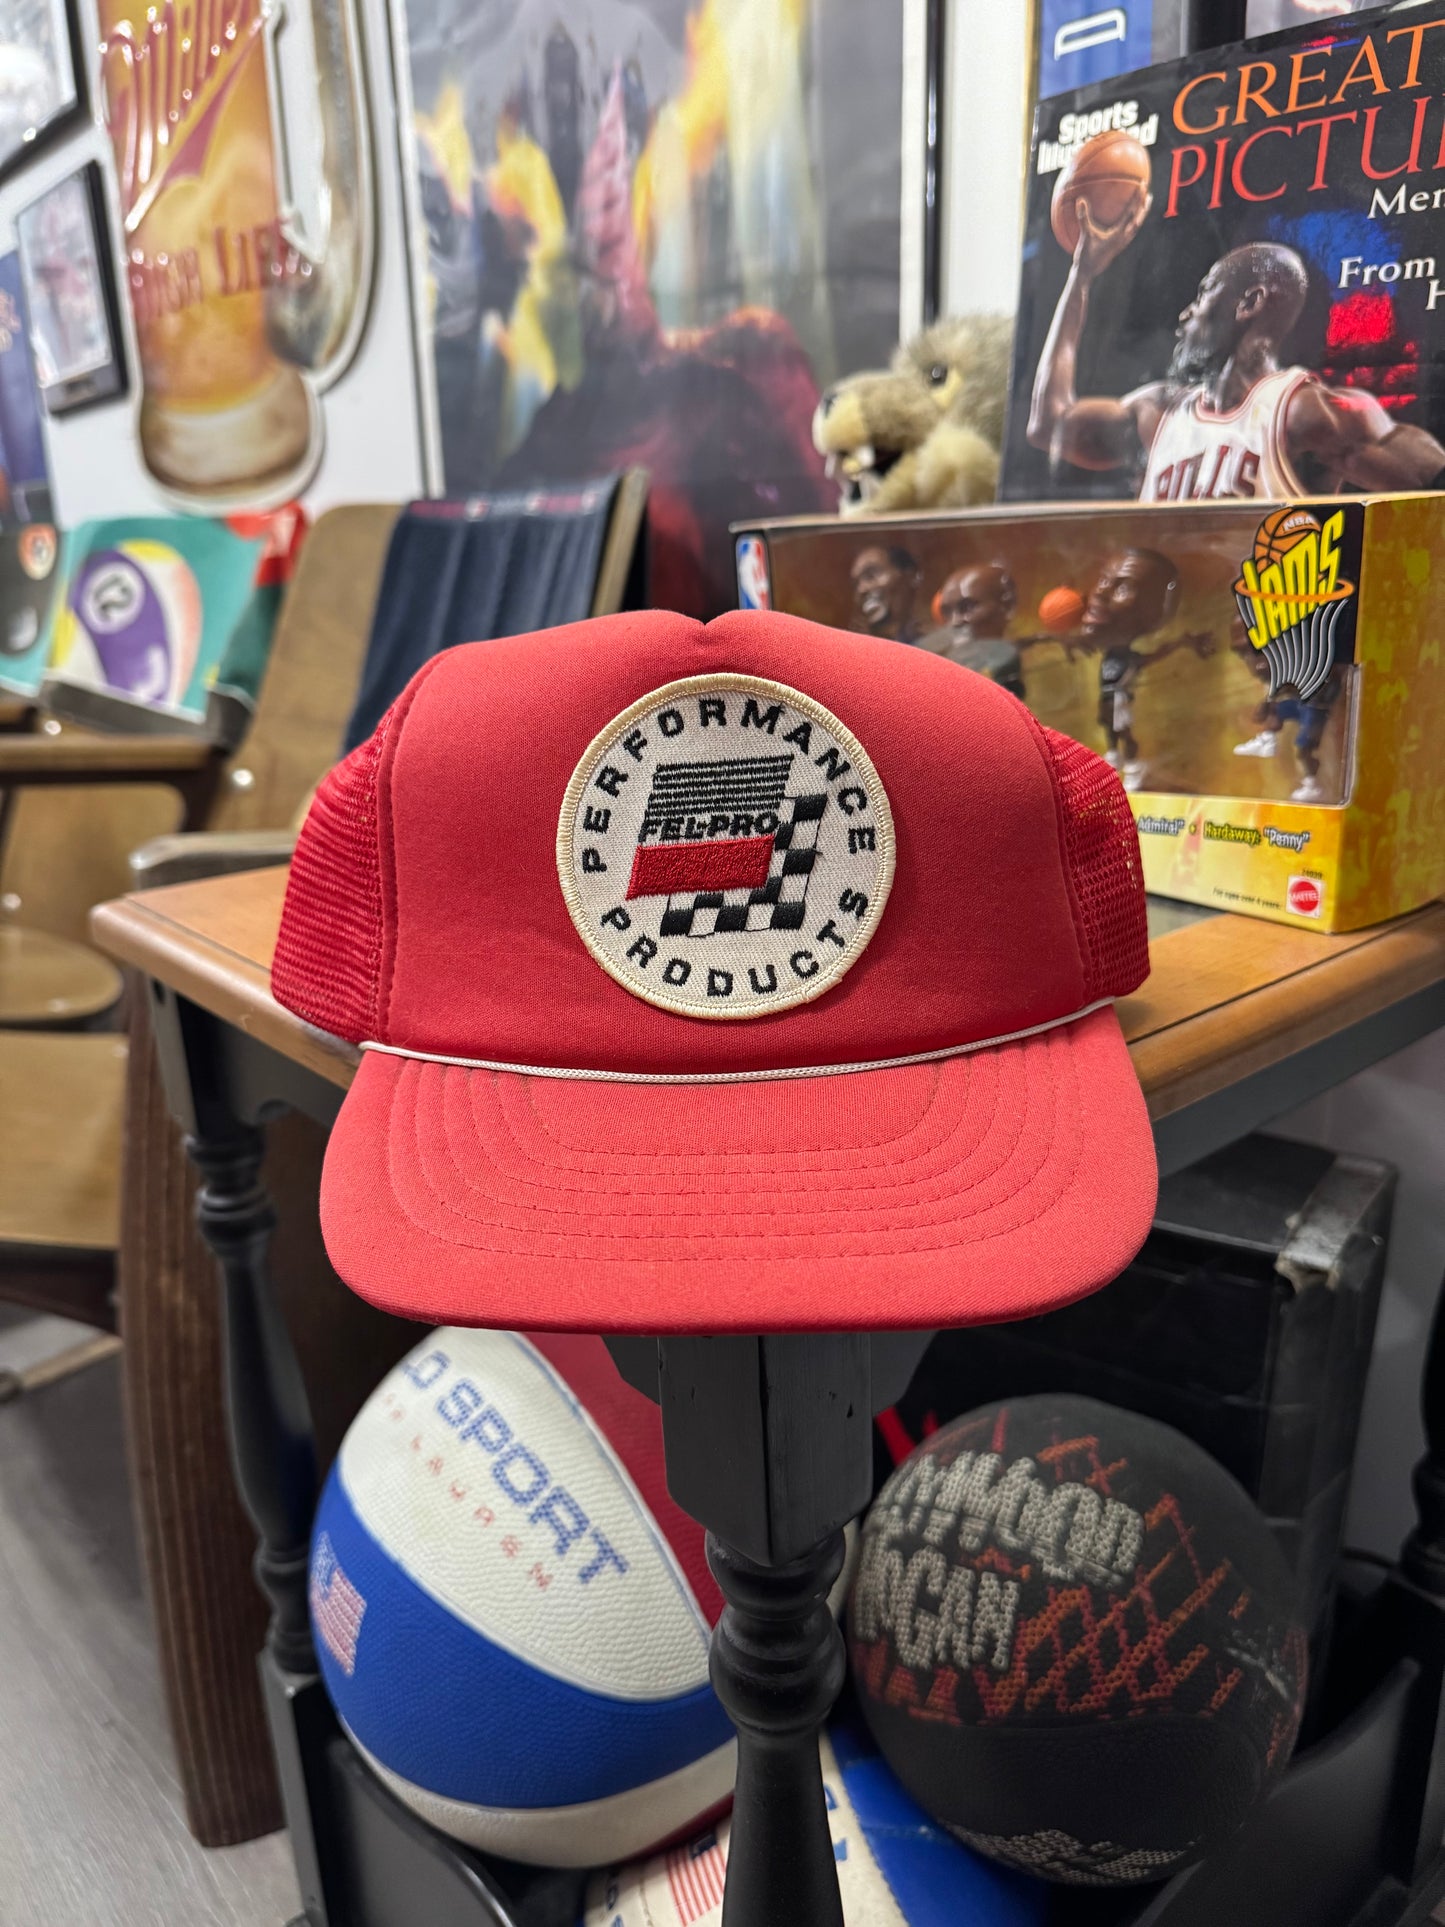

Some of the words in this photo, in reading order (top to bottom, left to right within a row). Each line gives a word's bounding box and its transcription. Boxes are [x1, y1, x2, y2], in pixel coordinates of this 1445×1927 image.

[1058, 100, 1140, 146] Sports
[1172, 19, 1445, 136] GREAT
[1338, 256, 1435, 289] From
[1283, 514, 1315, 531] NBA
[1242, 510, 1345, 650] JAMS
[582, 698, 876, 875] PERFORMANCE
[637, 811, 781, 843] FEL-PRO
[601, 887, 869, 998] PRODUCTS
[437, 1377, 632, 1587] SPORT
